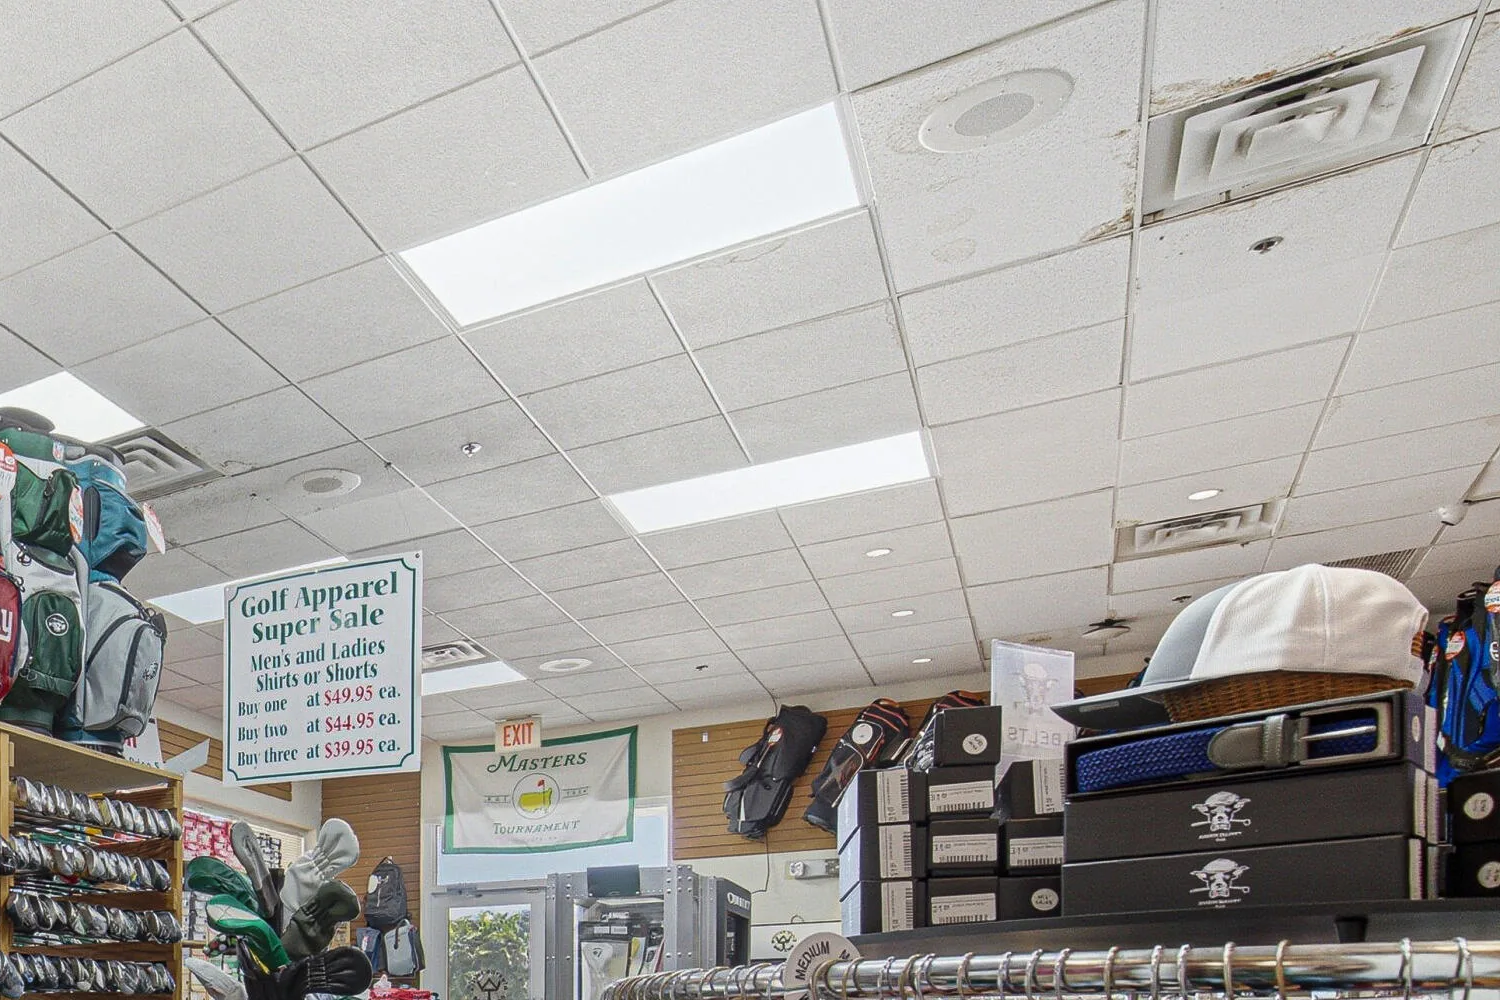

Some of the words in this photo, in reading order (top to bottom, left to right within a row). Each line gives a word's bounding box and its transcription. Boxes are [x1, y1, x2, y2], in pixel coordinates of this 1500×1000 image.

[241, 586, 290, 618] Golf
[295, 571, 399, 613] Apparel
[252, 617, 322, 645] Super
[329, 603, 385, 632] Sale
[250, 648, 291, 673] Men's
[295, 642, 325, 665] and
[332, 638, 386, 660] Ladies
[256, 671, 299, 693] Shirts
[303, 669, 321, 686] or
[326, 661, 378, 683] Shorts
[238, 701, 261, 720] Buy
[264, 698, 288, 712] one
[306, 692, 320, 708] at
[324, 685, 373, 707] $49.95
[379, 687, 401, 700] ea.
[238, 726, 261, 744] Buy
[264, 723, 288, 739] two
[306, 718, 320, 734] at
[325, 711, 375, 733] $44.95
[378, 713, 401, 727] ea.
[503, 722, 534, 747] EXIT
[237, 751, 261, 769] Buy
[264, 747, 299, 763] three
[306, 743, 320, 760] at
[325, 738, 374, 760] $39.95
[378, 740, 401, 753] ea.
[487, 752, 588, 774] MASTERS
[493, 819, 581, 835] TOURNAMENT
[795, 941, 831, 981] MEDIUM
